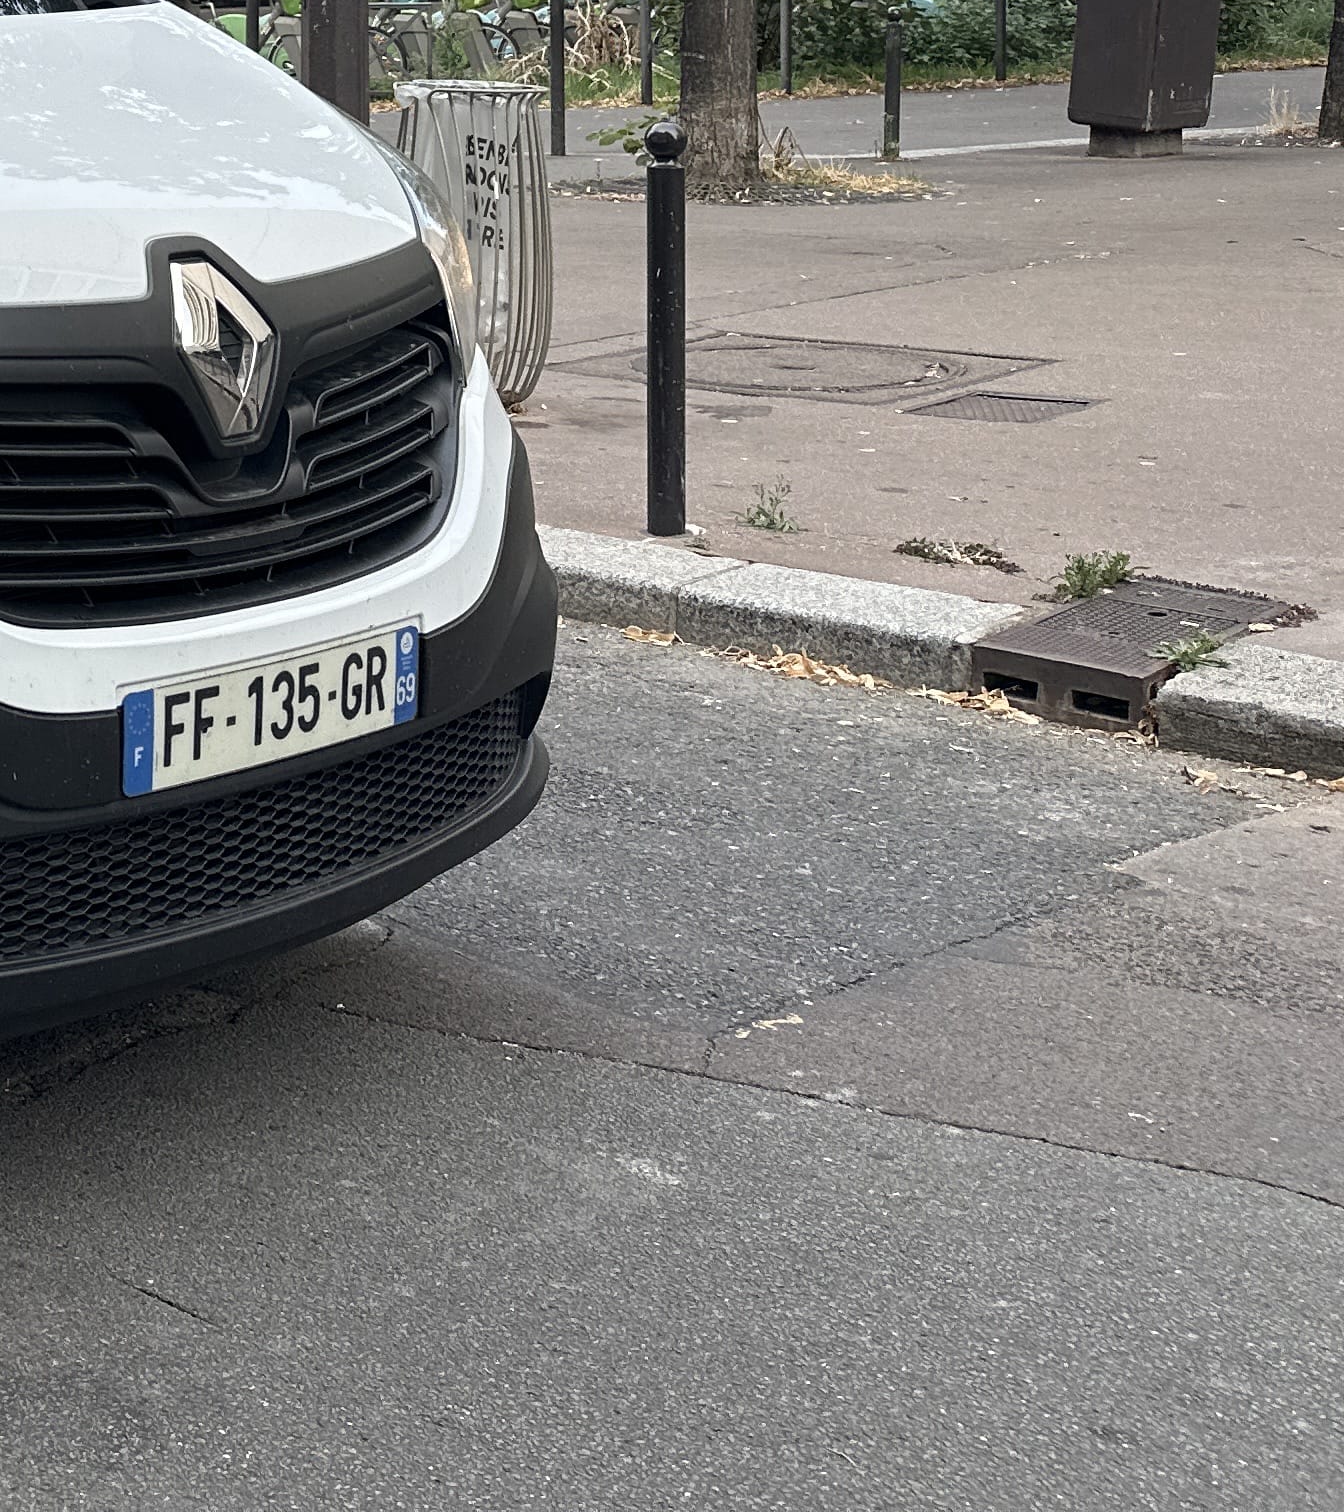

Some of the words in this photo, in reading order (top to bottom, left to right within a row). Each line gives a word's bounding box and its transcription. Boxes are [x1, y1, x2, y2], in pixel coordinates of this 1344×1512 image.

[396, 672, 416, 706] 69
[163, 645, 387, 768] FF-135-GR
[133, 746, 144, 768] F
